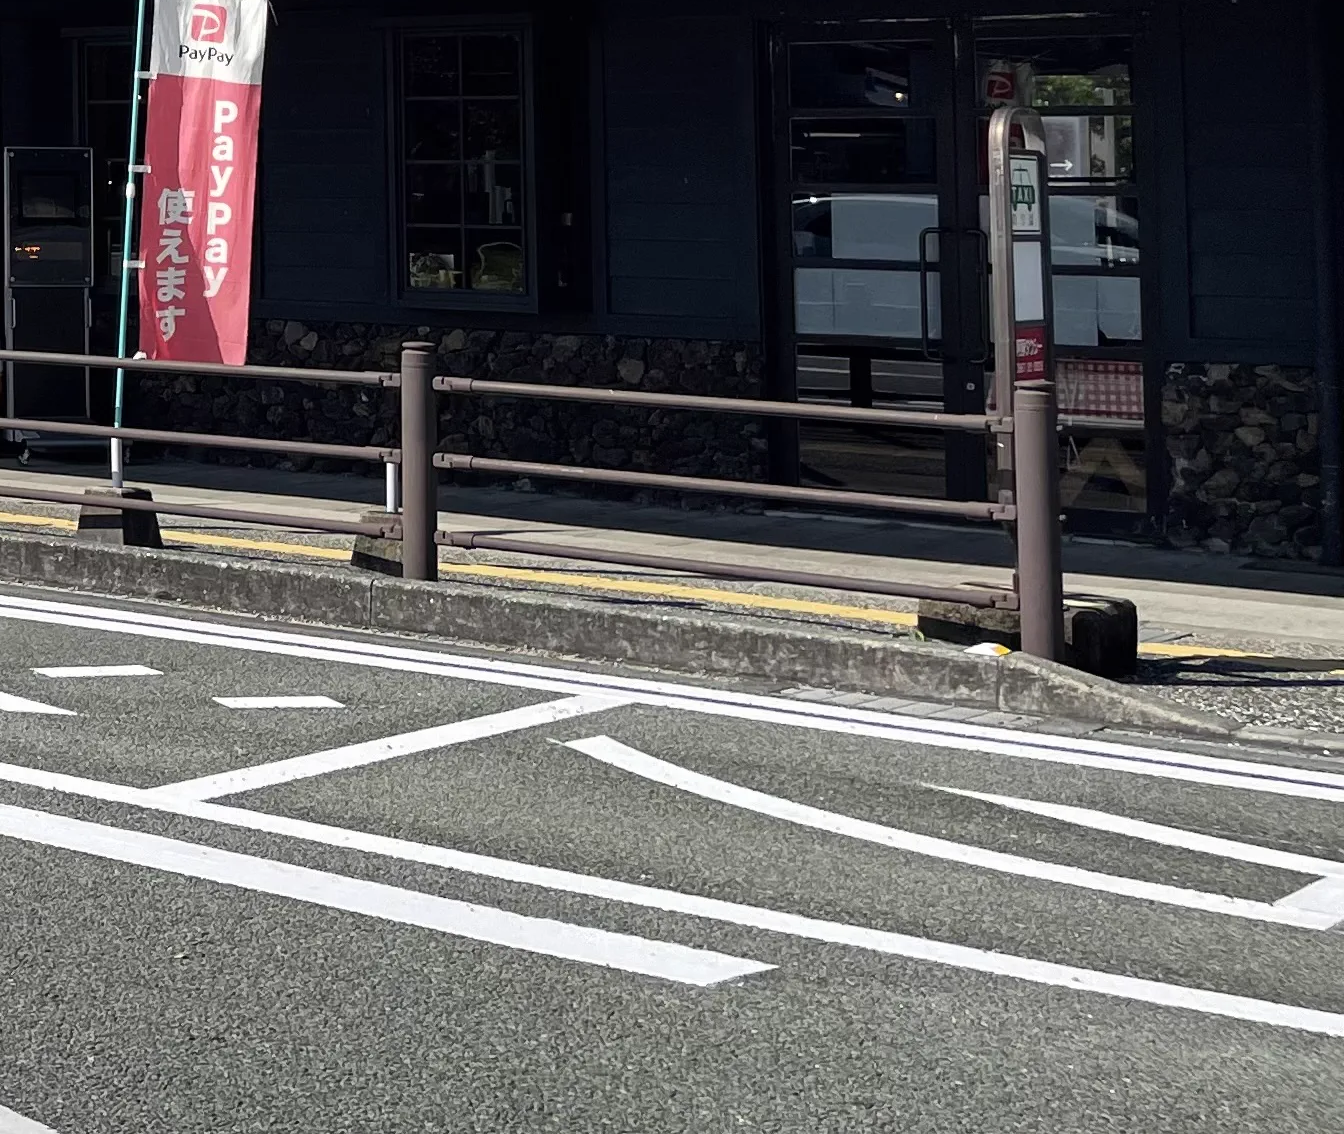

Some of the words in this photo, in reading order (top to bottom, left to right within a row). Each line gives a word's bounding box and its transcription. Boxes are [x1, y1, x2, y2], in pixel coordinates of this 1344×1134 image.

[178, 44, 235, 67] PayPay
[155, 188, 196, 342] 使えます
[203, 100, 239, 298] PayPay
